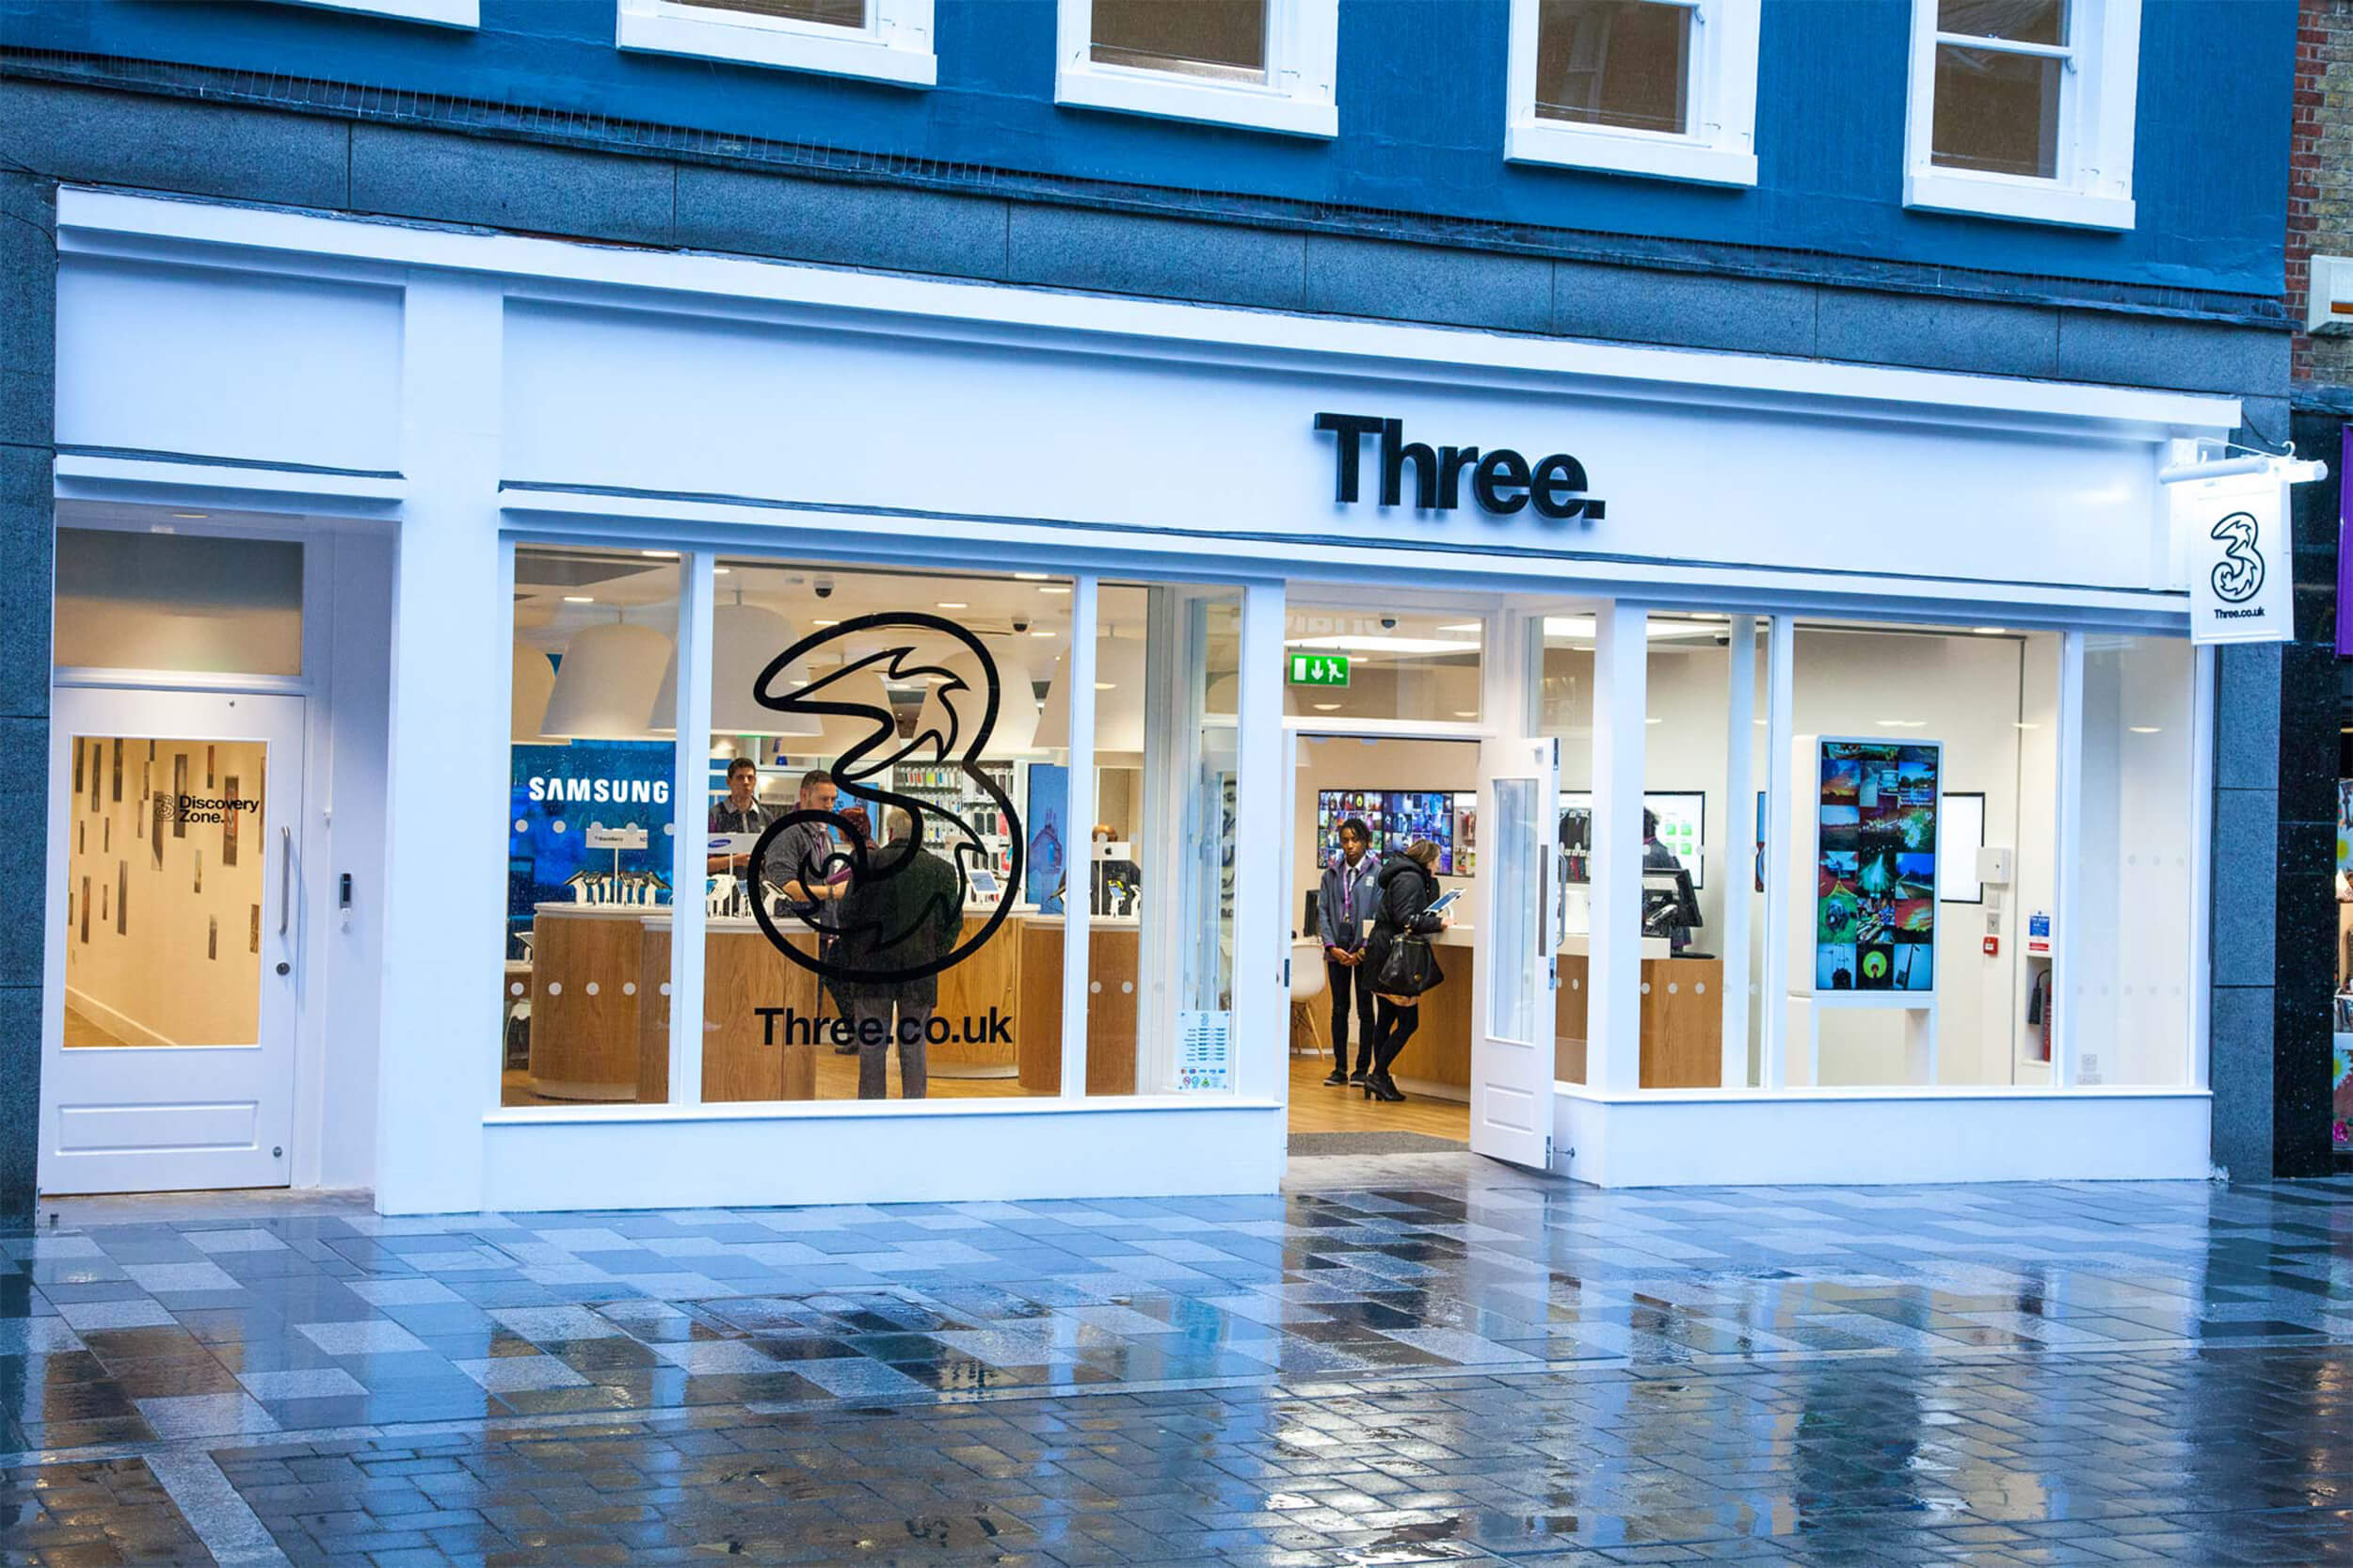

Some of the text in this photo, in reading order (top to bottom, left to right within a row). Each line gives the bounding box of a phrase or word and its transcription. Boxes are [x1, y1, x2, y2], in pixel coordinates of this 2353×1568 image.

[1314, 412, 1606, 520] Three.
[2211, 511, 2265, 603] 3
[2214, 607, 2265, 619] Three.co.uk
[179, 795, 259, 813] Discovery
[529, 776, 669, 804] SAMSUNG
[747, 612, 1023, 983] 3
[179, 809, 225, 824] Zone.
[754, 1006, 1013, 1046] Three.co.uk
